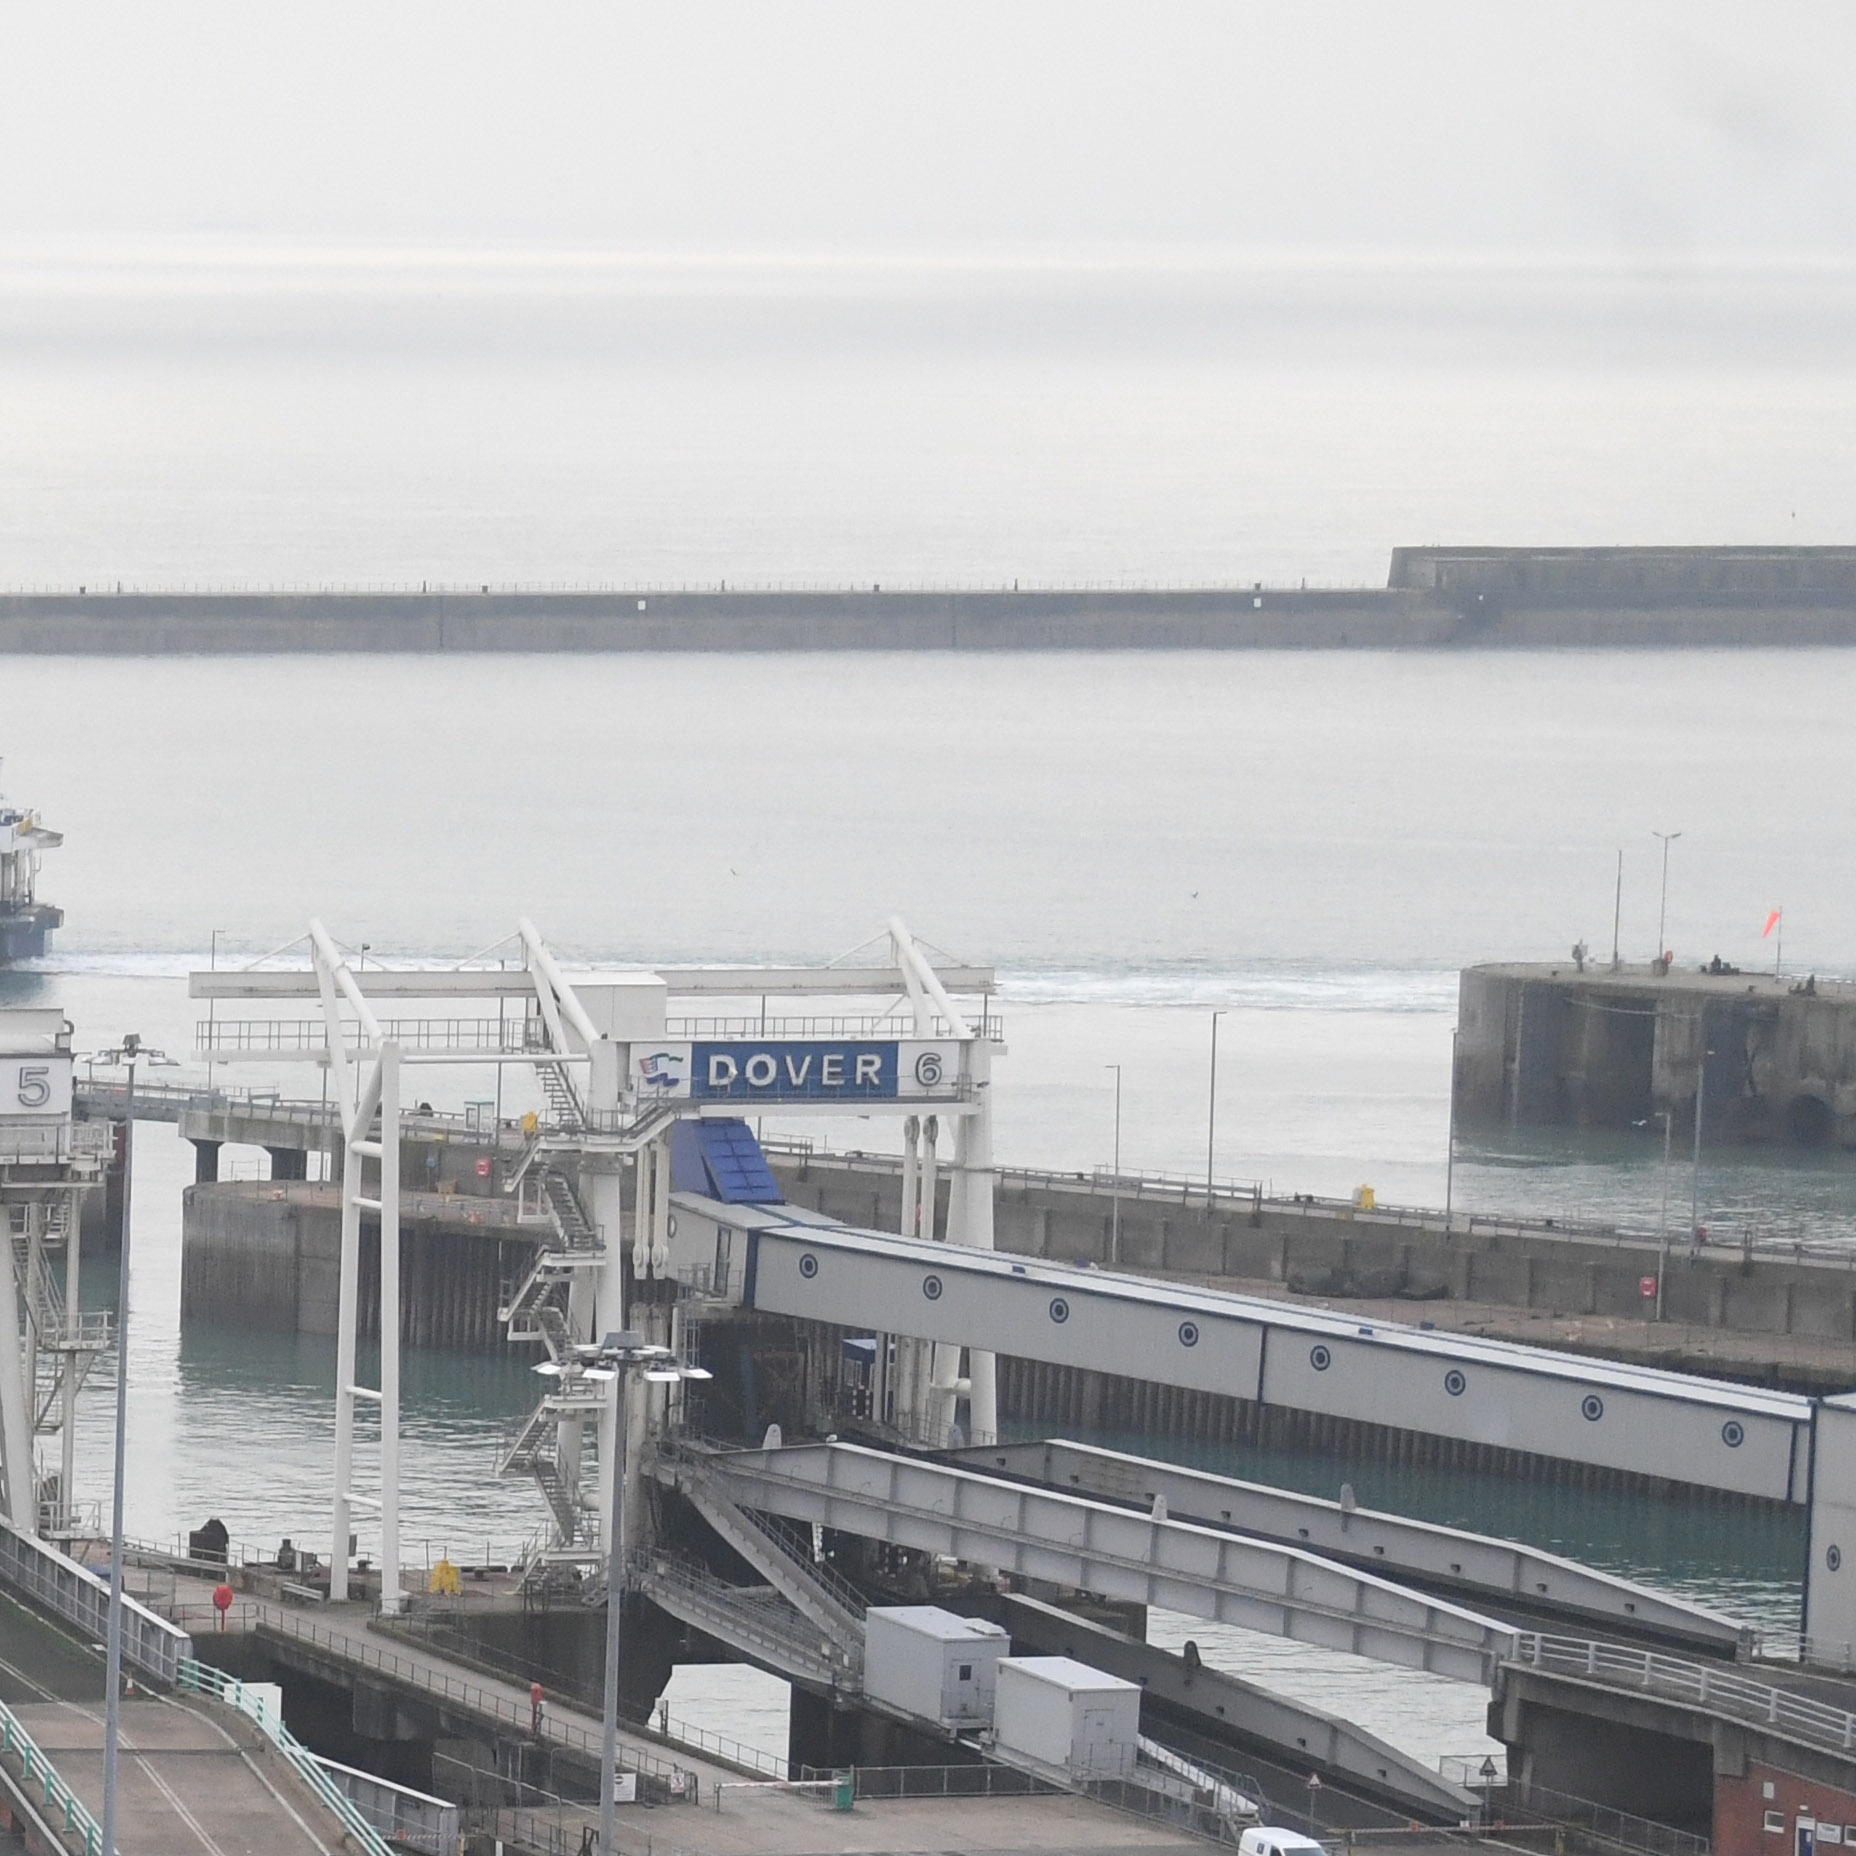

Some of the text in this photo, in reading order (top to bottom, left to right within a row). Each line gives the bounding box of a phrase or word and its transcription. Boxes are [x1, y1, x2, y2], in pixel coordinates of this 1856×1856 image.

[18, 1066, 51, 1107] 5
[707, 1052, 943, 1087] DOVER 6
